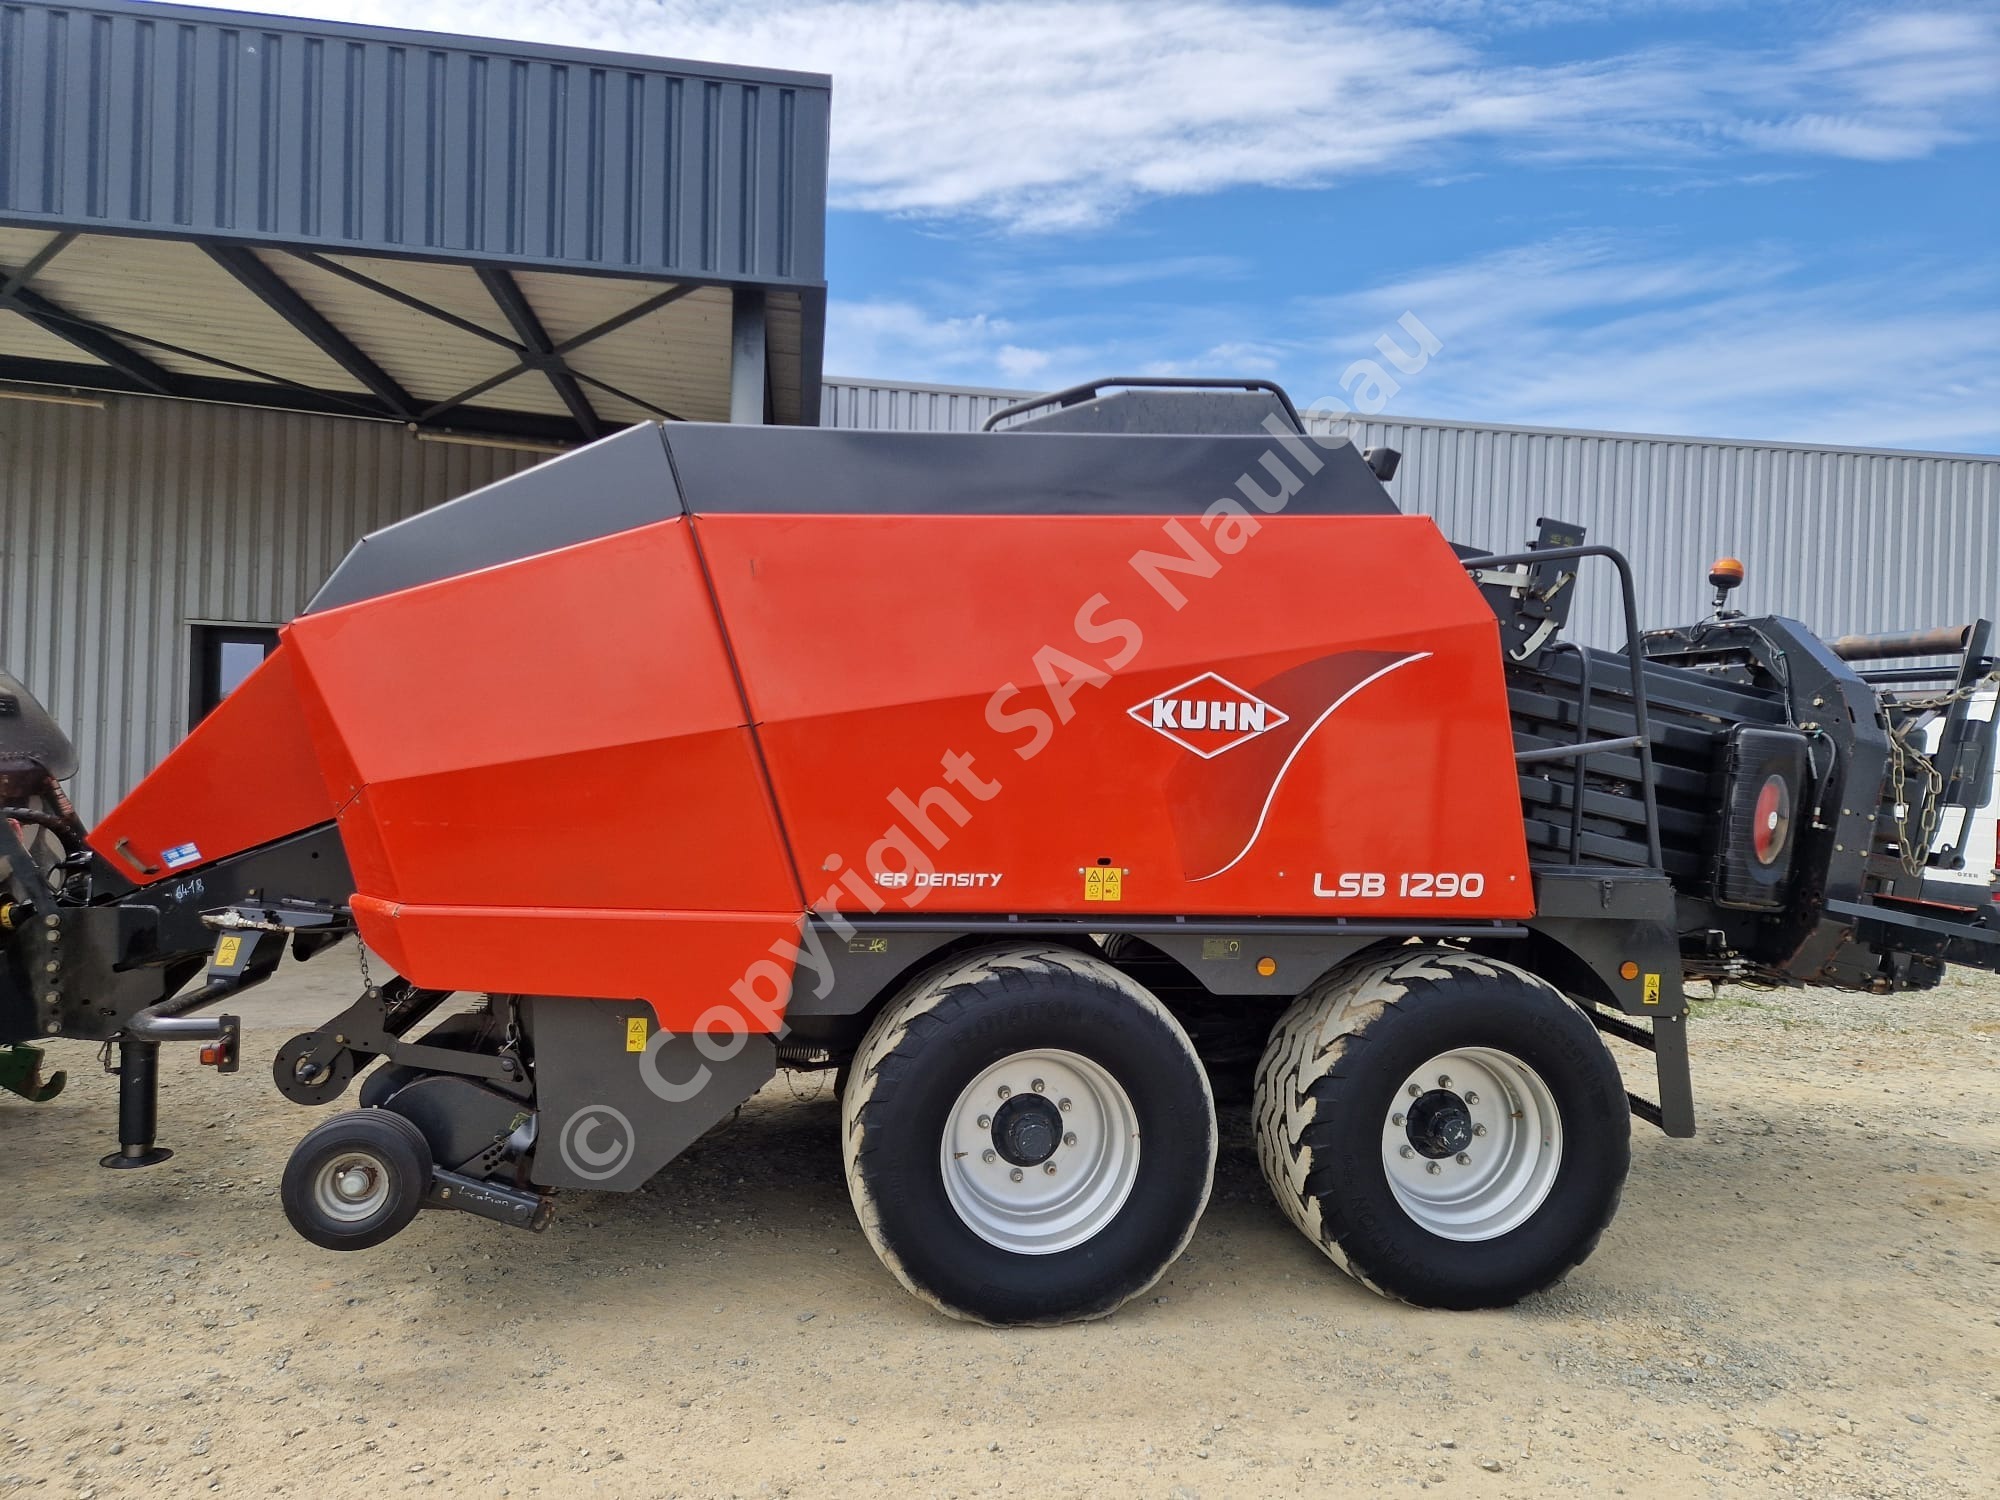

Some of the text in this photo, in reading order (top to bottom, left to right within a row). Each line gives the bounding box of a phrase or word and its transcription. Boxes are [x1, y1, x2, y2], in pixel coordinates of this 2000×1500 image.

[1152, 699, 1266, 732] KUHN
[915, 873, 1003, 887] DENSITY
[1313, 873, 1484, 898] LSB 1290
